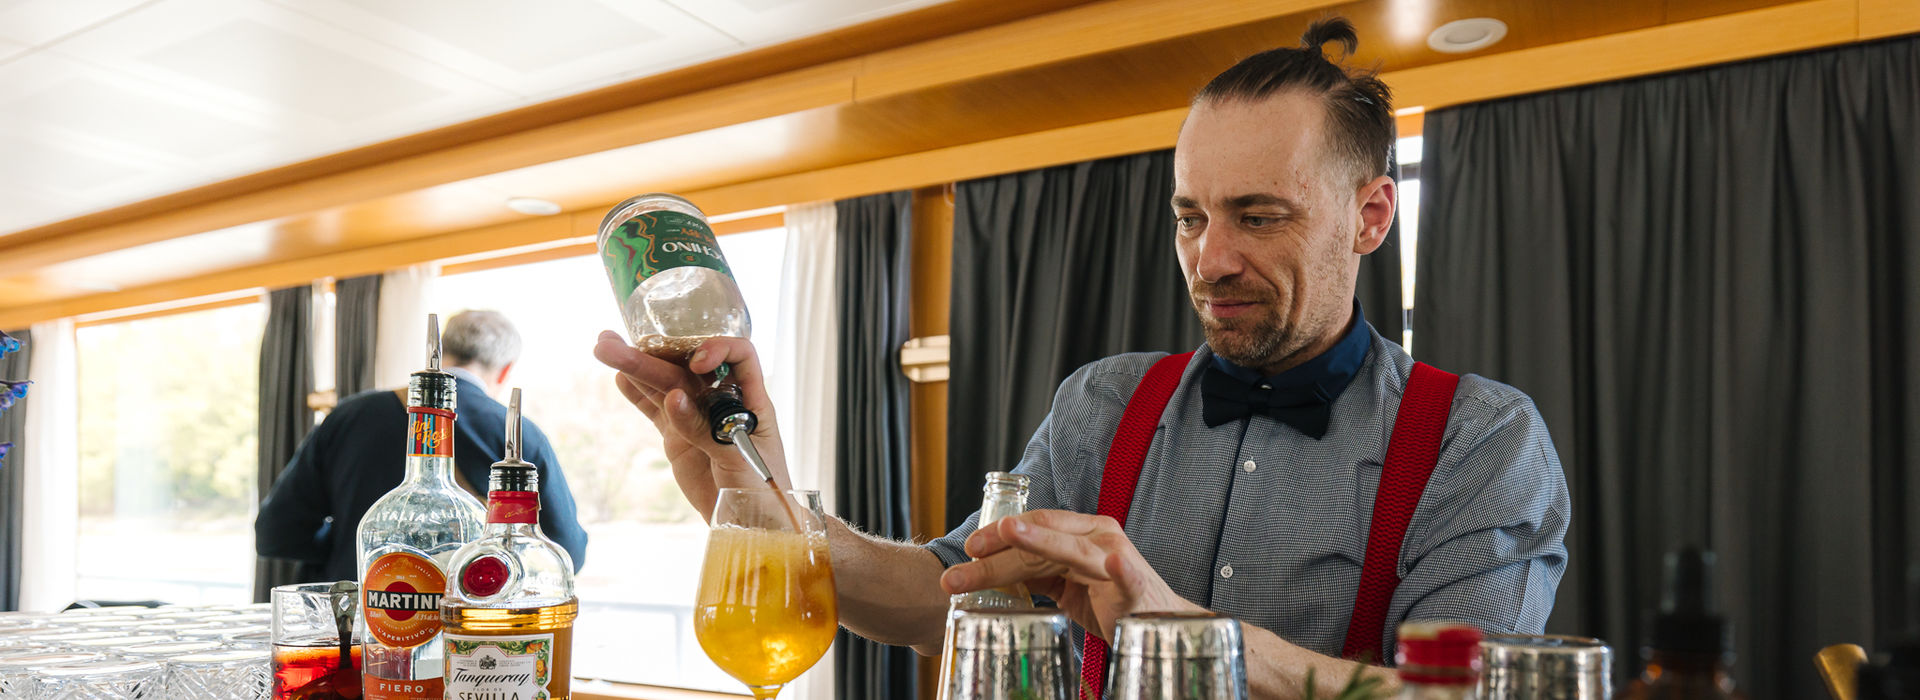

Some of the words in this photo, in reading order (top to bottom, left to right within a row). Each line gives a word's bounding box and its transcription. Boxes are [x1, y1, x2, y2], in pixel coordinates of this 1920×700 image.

[368, 591, 440, 610] MARTINI
[453, 667, 531, 687] Tanqueray
[380, 683, 424, 693] FIERO
